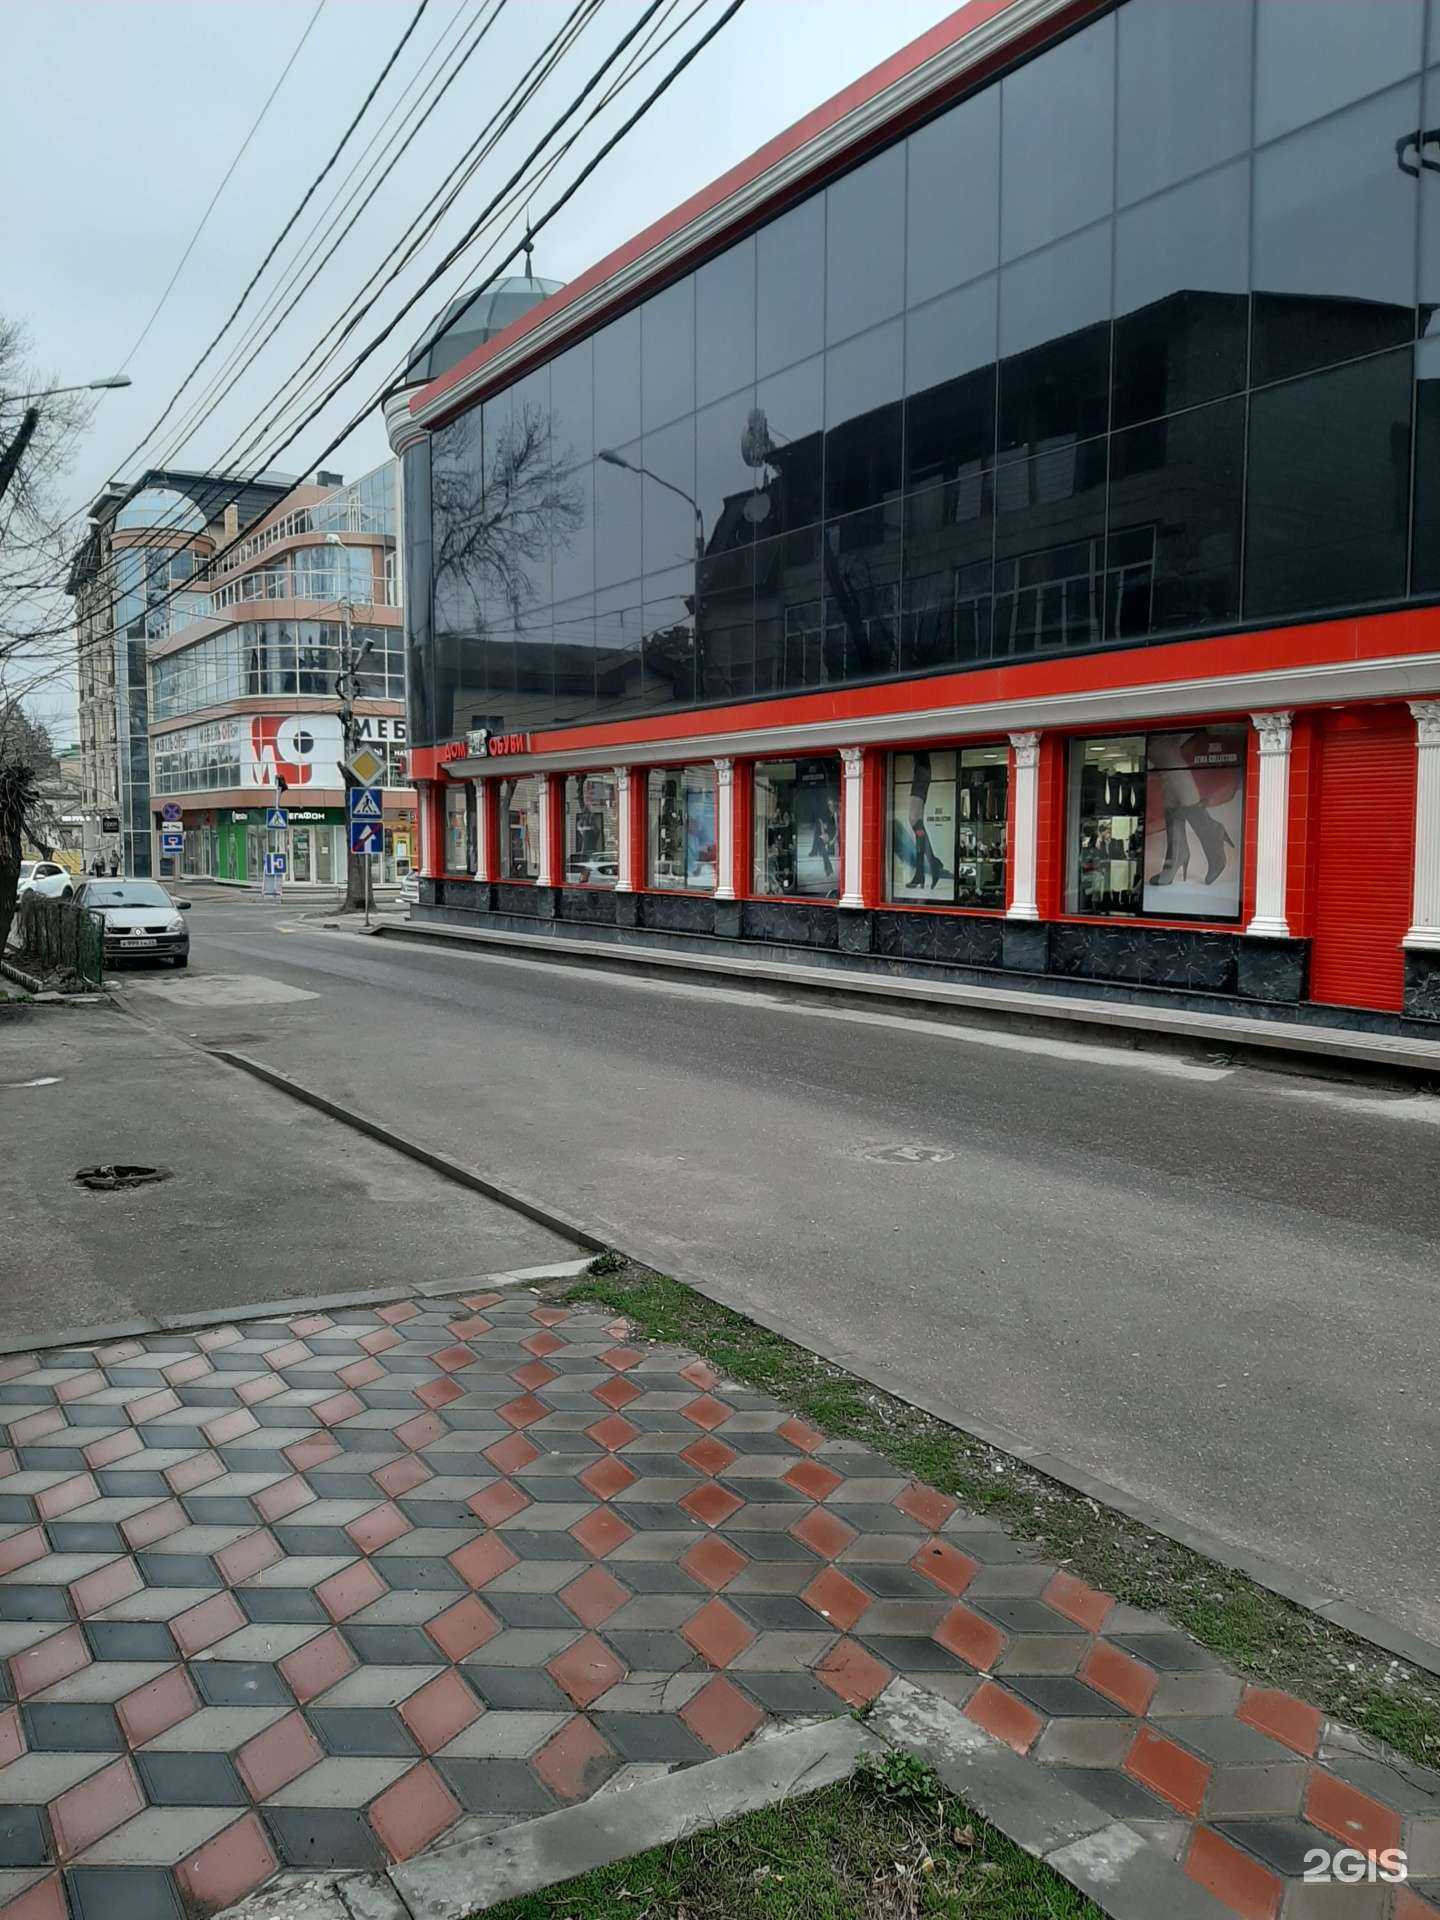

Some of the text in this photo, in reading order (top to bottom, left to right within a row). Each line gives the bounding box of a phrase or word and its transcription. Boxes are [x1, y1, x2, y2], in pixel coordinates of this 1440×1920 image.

[445, 733, 524, 760] ДОМ ОБУВИ
[288, 811, 325, 820] ЕГАФОН
